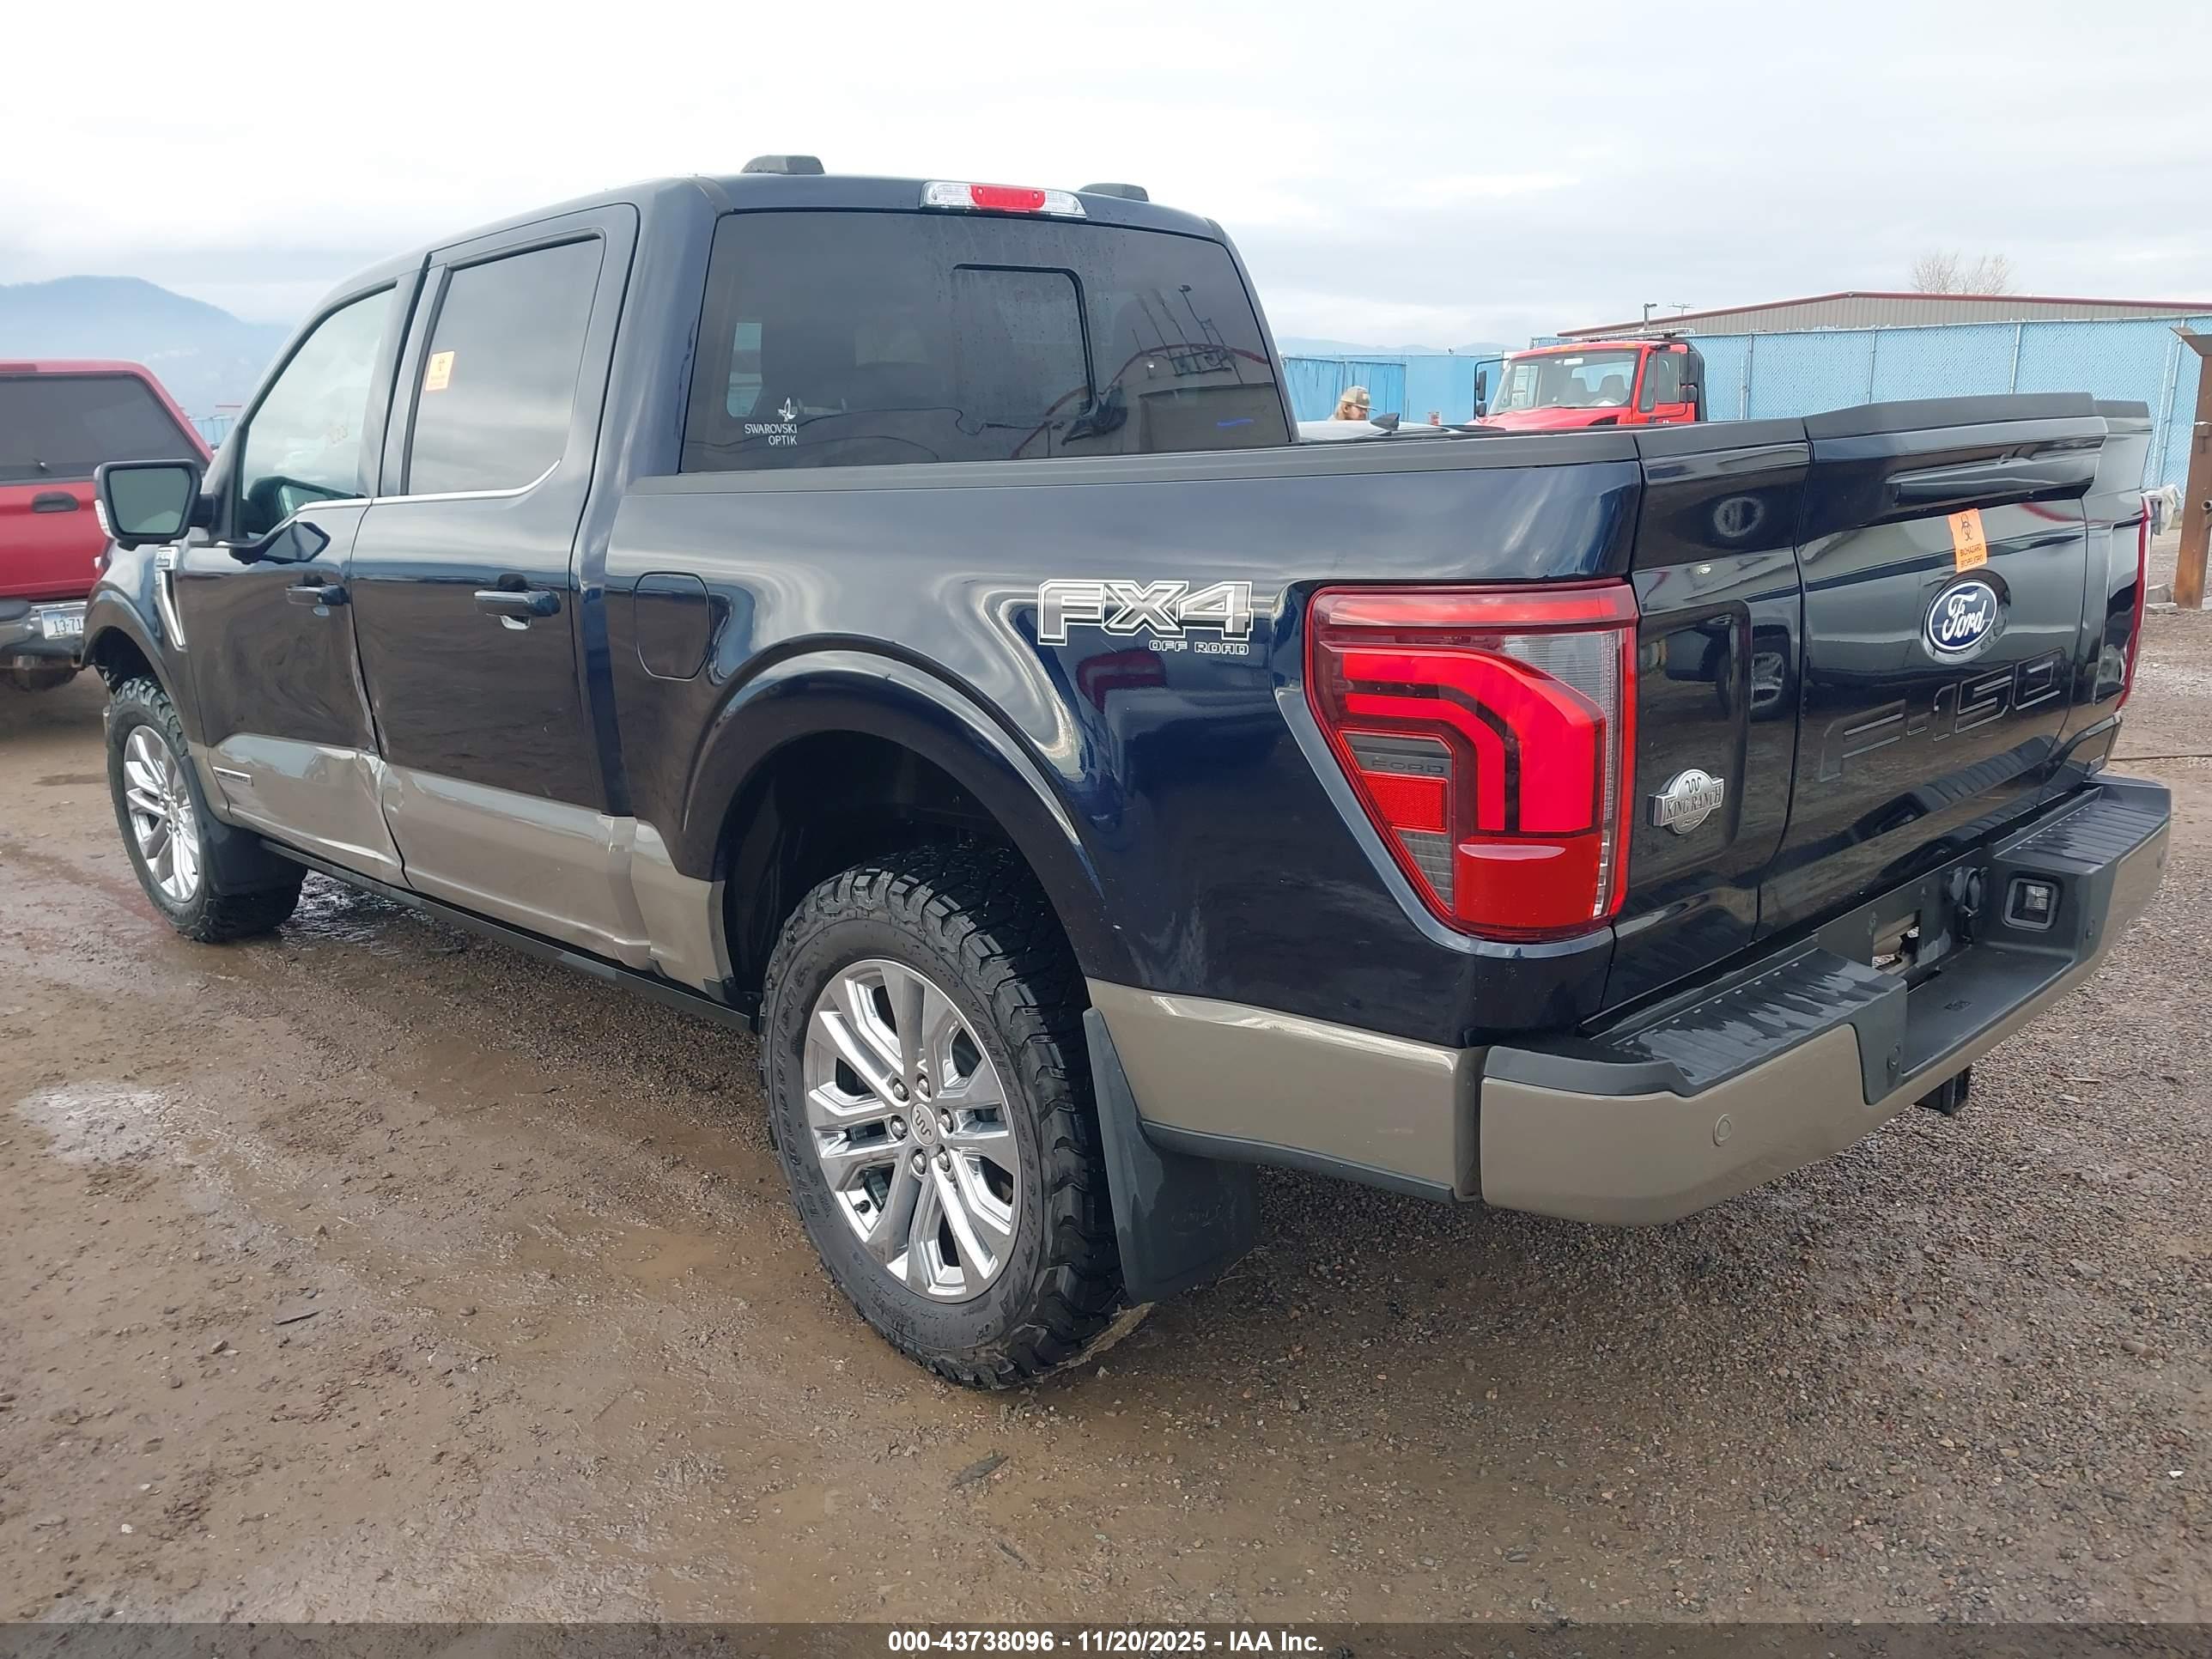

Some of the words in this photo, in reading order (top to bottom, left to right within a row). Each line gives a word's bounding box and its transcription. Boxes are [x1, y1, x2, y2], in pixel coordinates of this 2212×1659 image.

[744, 423, 798, 434] SWAROVSKI
[768, 434, 798, 446] OPTIK
[1037, 578, 1254, 646] FX4
[1942, 592, 1987, 641] Ford
[1148, 639, 1188, 653] OFF
[1194, 641, 1249, 655] ROAD
[1820, 647, 2066, 783] F-150
[1371, 759, 1444, 774] FORD
[1667, 799, 1689, 819] KING
[1691, 784, 1723, 811] RANCH
